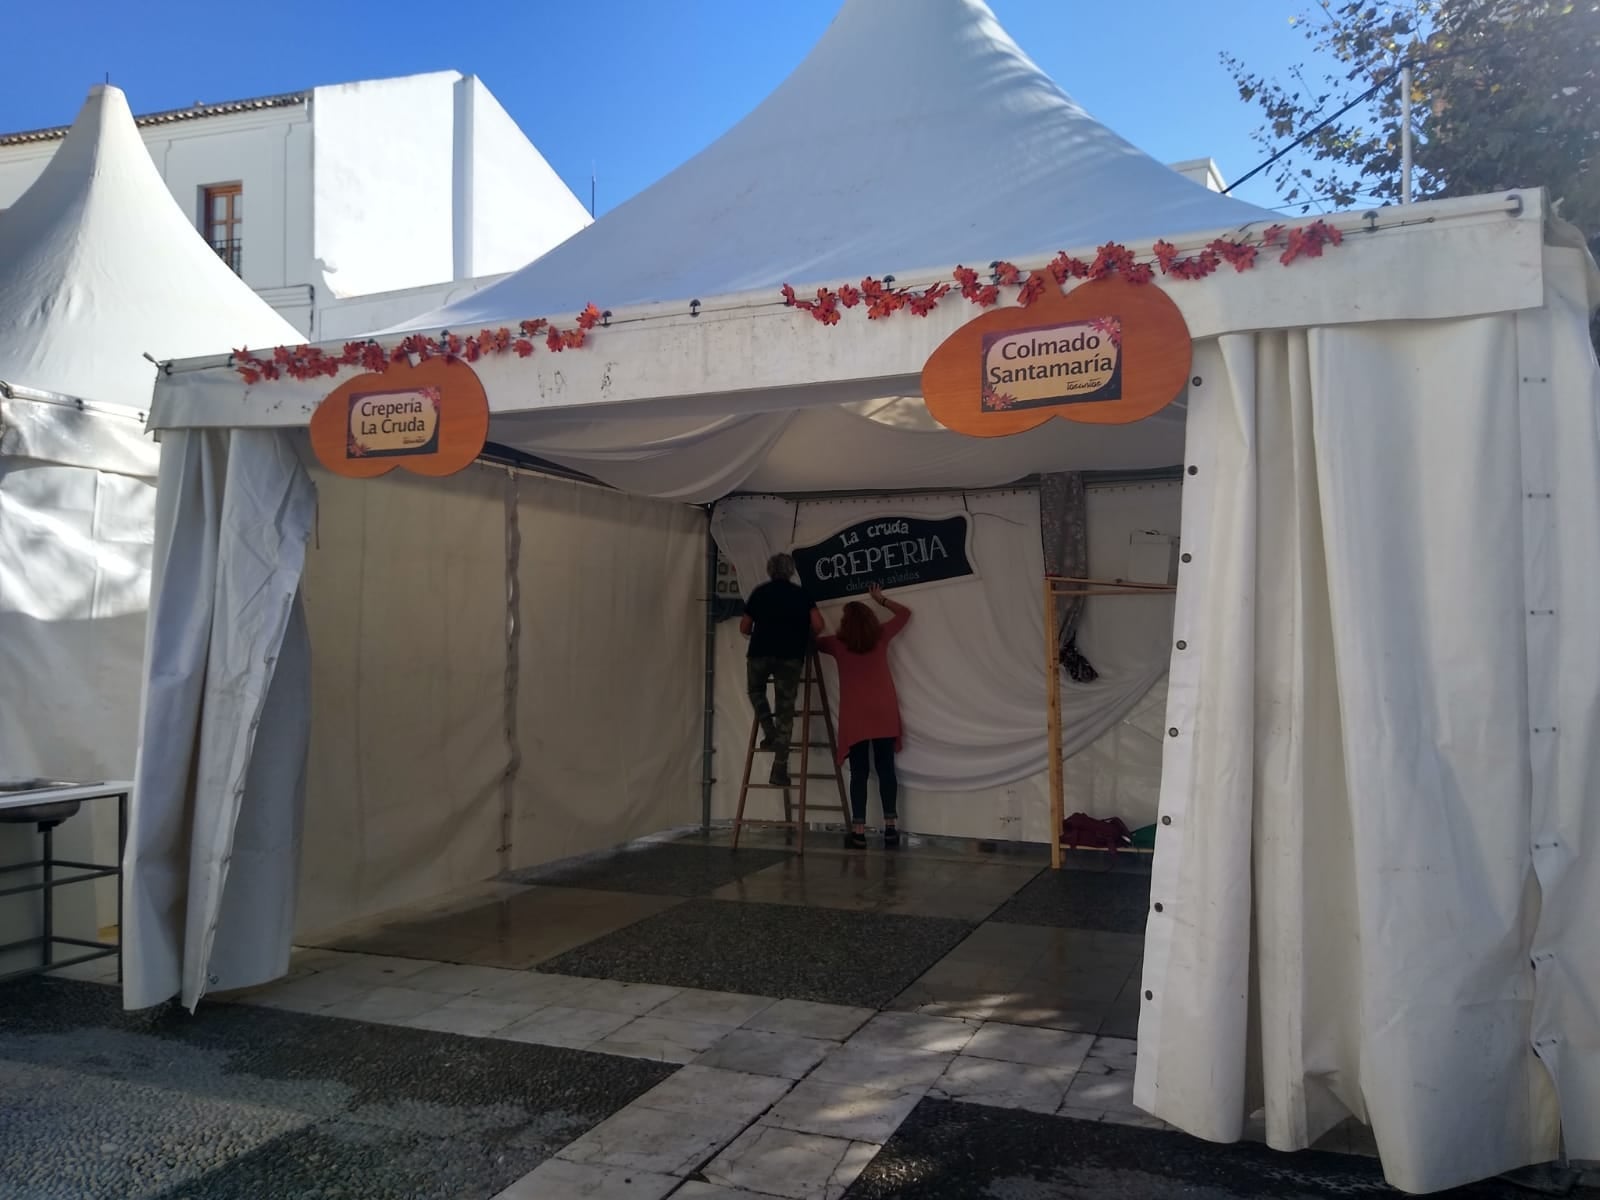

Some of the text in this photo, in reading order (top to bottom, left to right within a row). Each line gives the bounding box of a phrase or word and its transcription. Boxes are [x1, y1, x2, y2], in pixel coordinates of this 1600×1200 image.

[1002, 332, 1100, 361] Colmado
[990, 353, 1113, 385] Santamaría
[361, 417, 425, 435] La Cruda
[866, 520, 910, 538] cruda
[815, 535, 949, 581] CREPERIA
